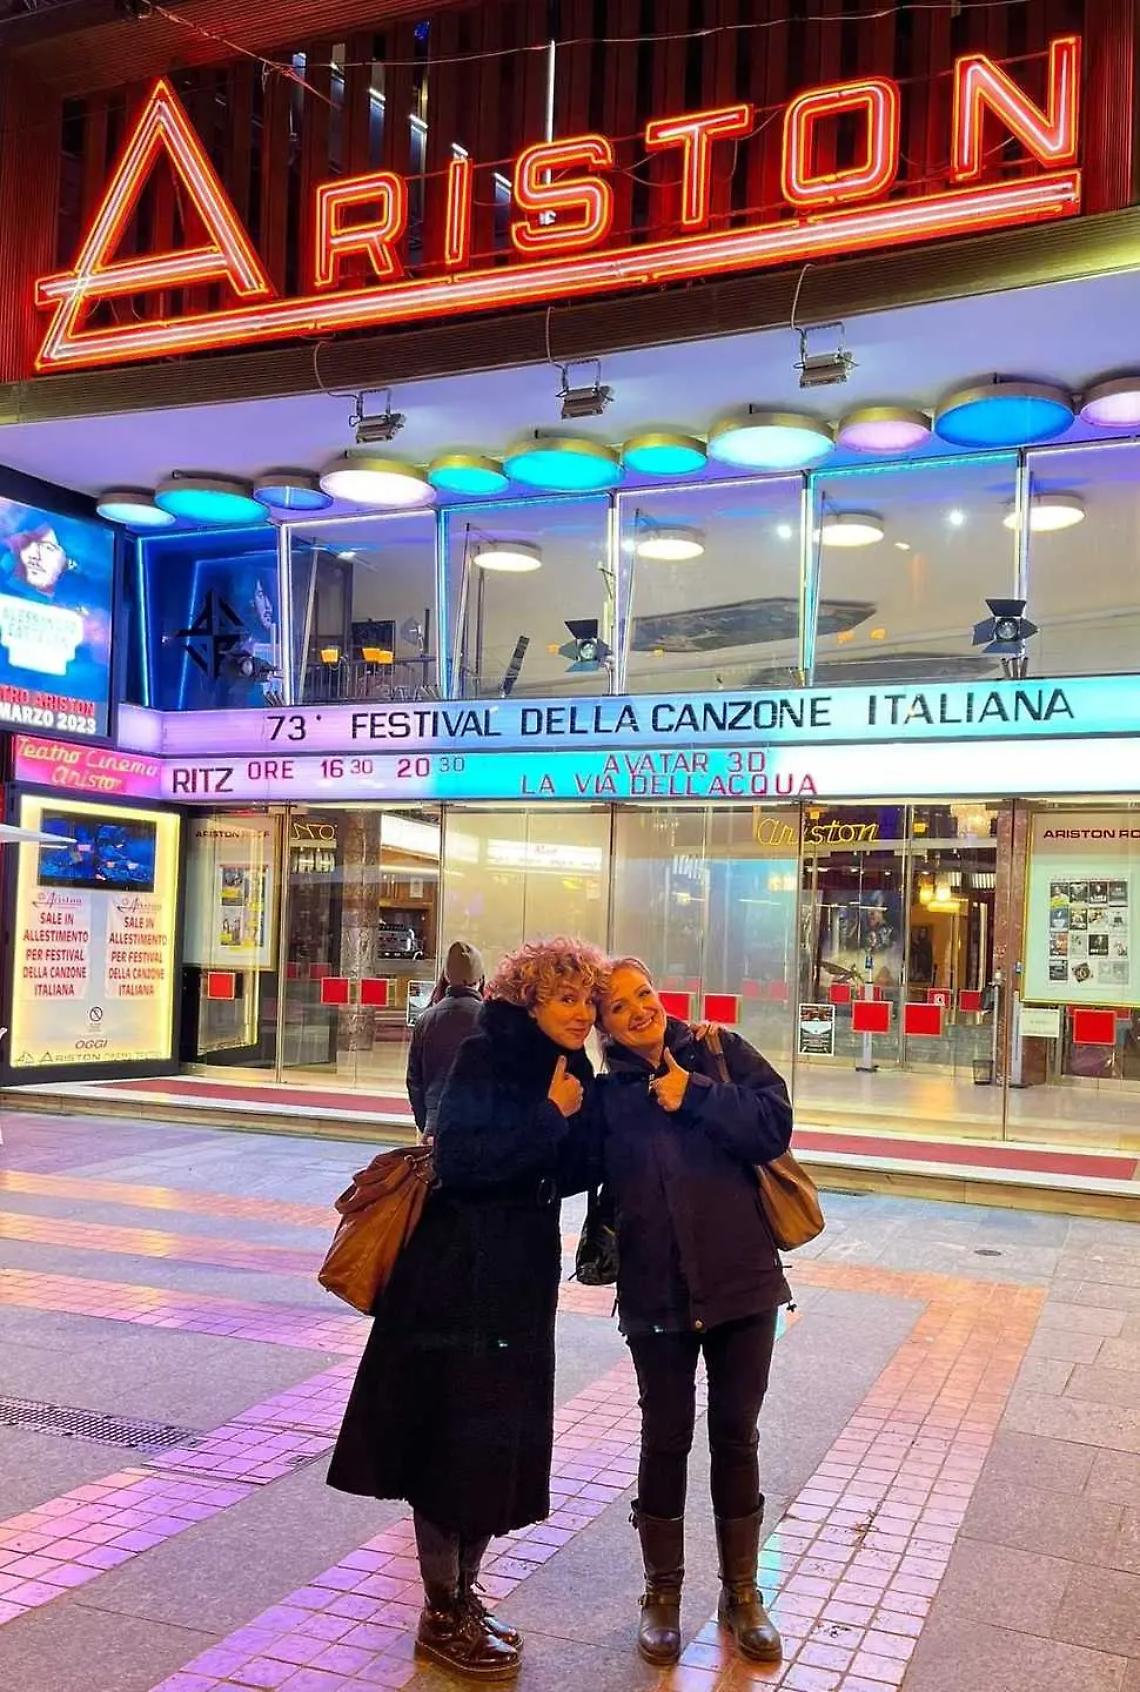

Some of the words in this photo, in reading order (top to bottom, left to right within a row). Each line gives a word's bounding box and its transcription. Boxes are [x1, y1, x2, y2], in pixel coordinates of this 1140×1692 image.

[352, 709, 502, 739] FESTIVAL
[520, 704, 639, 736] DELLA
[651, 697, 832, 732] CANZONE
[868, 688, 1075, 726] ITALIANA
[57, 711, 97, 734] 2023
[247, 760, 294, 780] ORE
[603, 752, 708, 775] AVATAR
[728, 751, 766, 773] 3D
[172, 767, 234, 793] RITZ
[522, 773, 555, 794] LA
[575, 772, 616, 794] VIA
[1043, 829, 1116, 840] ARISTON
[39, 912, 63, 926] SALE
[65, 912, 75, 926] IN
[124, 916, 145, 929] SALE
[23, 929, 89, 944] ALLESTIMENTO
[109, 932, 168, 946] ALLESTIMENTO
[26, 948, 44, 961] PER
[45, 948, 85, 962] FESTIVAL
[111, 951, 128, 963] PER
[129, 951, 163, 964] FESTIVAL
[23, 966, 48, 979] DELLA
[50, 966, 87, 979] CANZONE
[108, 967, 131, 980] DELLA
[34, 983, 75, 997] ITALIANA
[74, 1039, 108, 1050] OGGI
